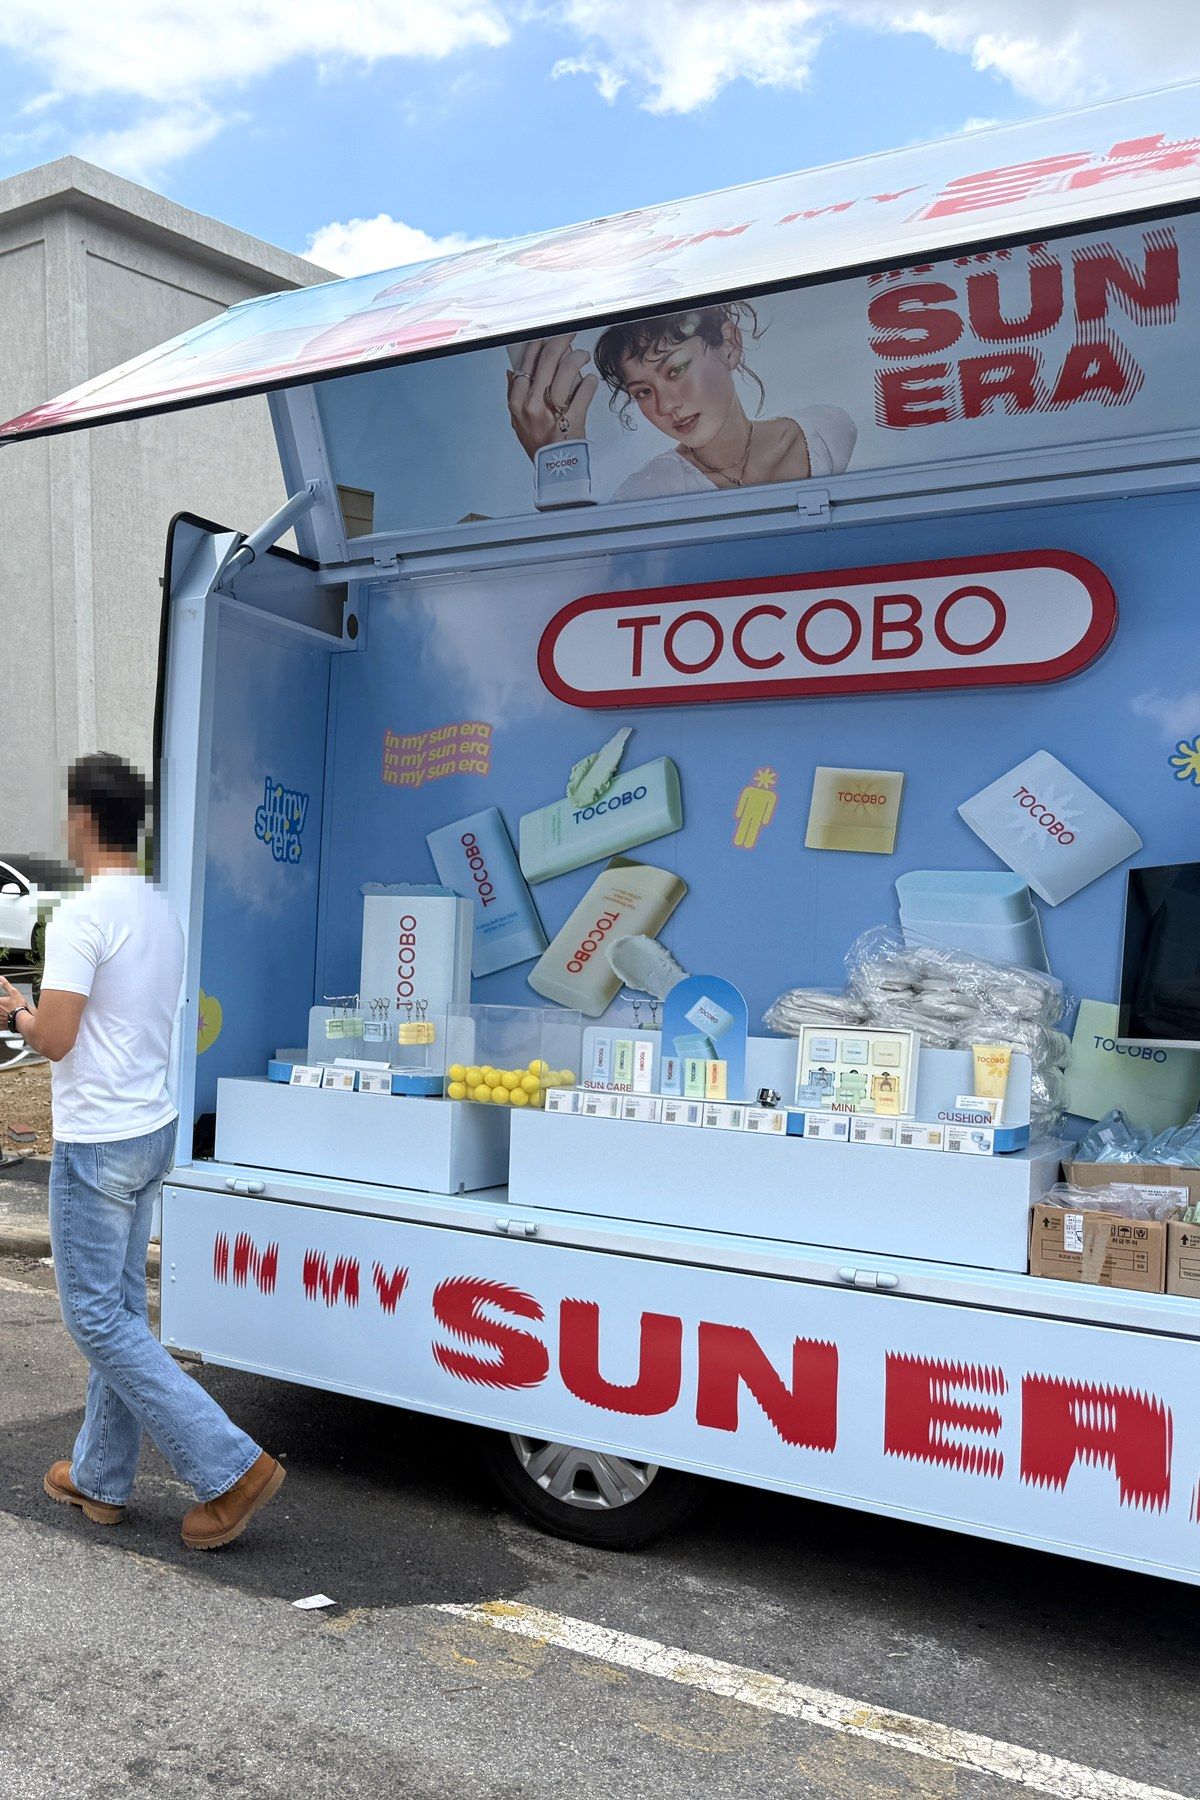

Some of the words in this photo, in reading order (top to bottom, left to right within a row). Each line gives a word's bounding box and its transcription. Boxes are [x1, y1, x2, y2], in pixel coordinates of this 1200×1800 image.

[868, 226, 1181, 361] SUN
[874, 343, 1146, 431] ERA
[545, 457, 578, 469] TOCOBO
[616, 585, 1007, 678] TOCOBO
[385, 731, 400, 748] in
[400, 734, 428, 750] my
[428, 725, 457, 744] sun
[460, 722, 490, 737] era
[384, 748, 400, 766] in
[400, 751, 427, 768] my
[427, 743, 457, 762] sun
[459, 740, 490, 755] era
[383, 765, 398, 783] in
[399, 769, 426, 787] my
[426, 762, 456, 780] sun
[458, 759, 490, 774] era
[572, 786, 647, 824] TOCOBO
[837, 792, 887, 806] TOCOBO
[1012, 786, 1075, 846] TOCOBO
[461, 832, 497, 908] TOCOBO
[566, 911, 620, 974] TOCOBO
[396, 914, 417, 1010] TOCOBO
[699, 1006, 719, 1024] TOCOBO
[976, 1056, 1005, 1064] TOCOBO
[1094, 1036, 1167, 1063] TOCOBO
[583, 1080, 605, 1090] SUN
[606, 1082, 633, 1093] CARE
[831, 1102, 856, 1113] MINI
[937, 1111, 993, 1125] CUSHION
[213, 1231, 280, 1296] IN
[303, 1247, 410, 1315] MY
[431, 1275, 839, 1454] SUN
[884, 1348, 1175, 1515] ERA
